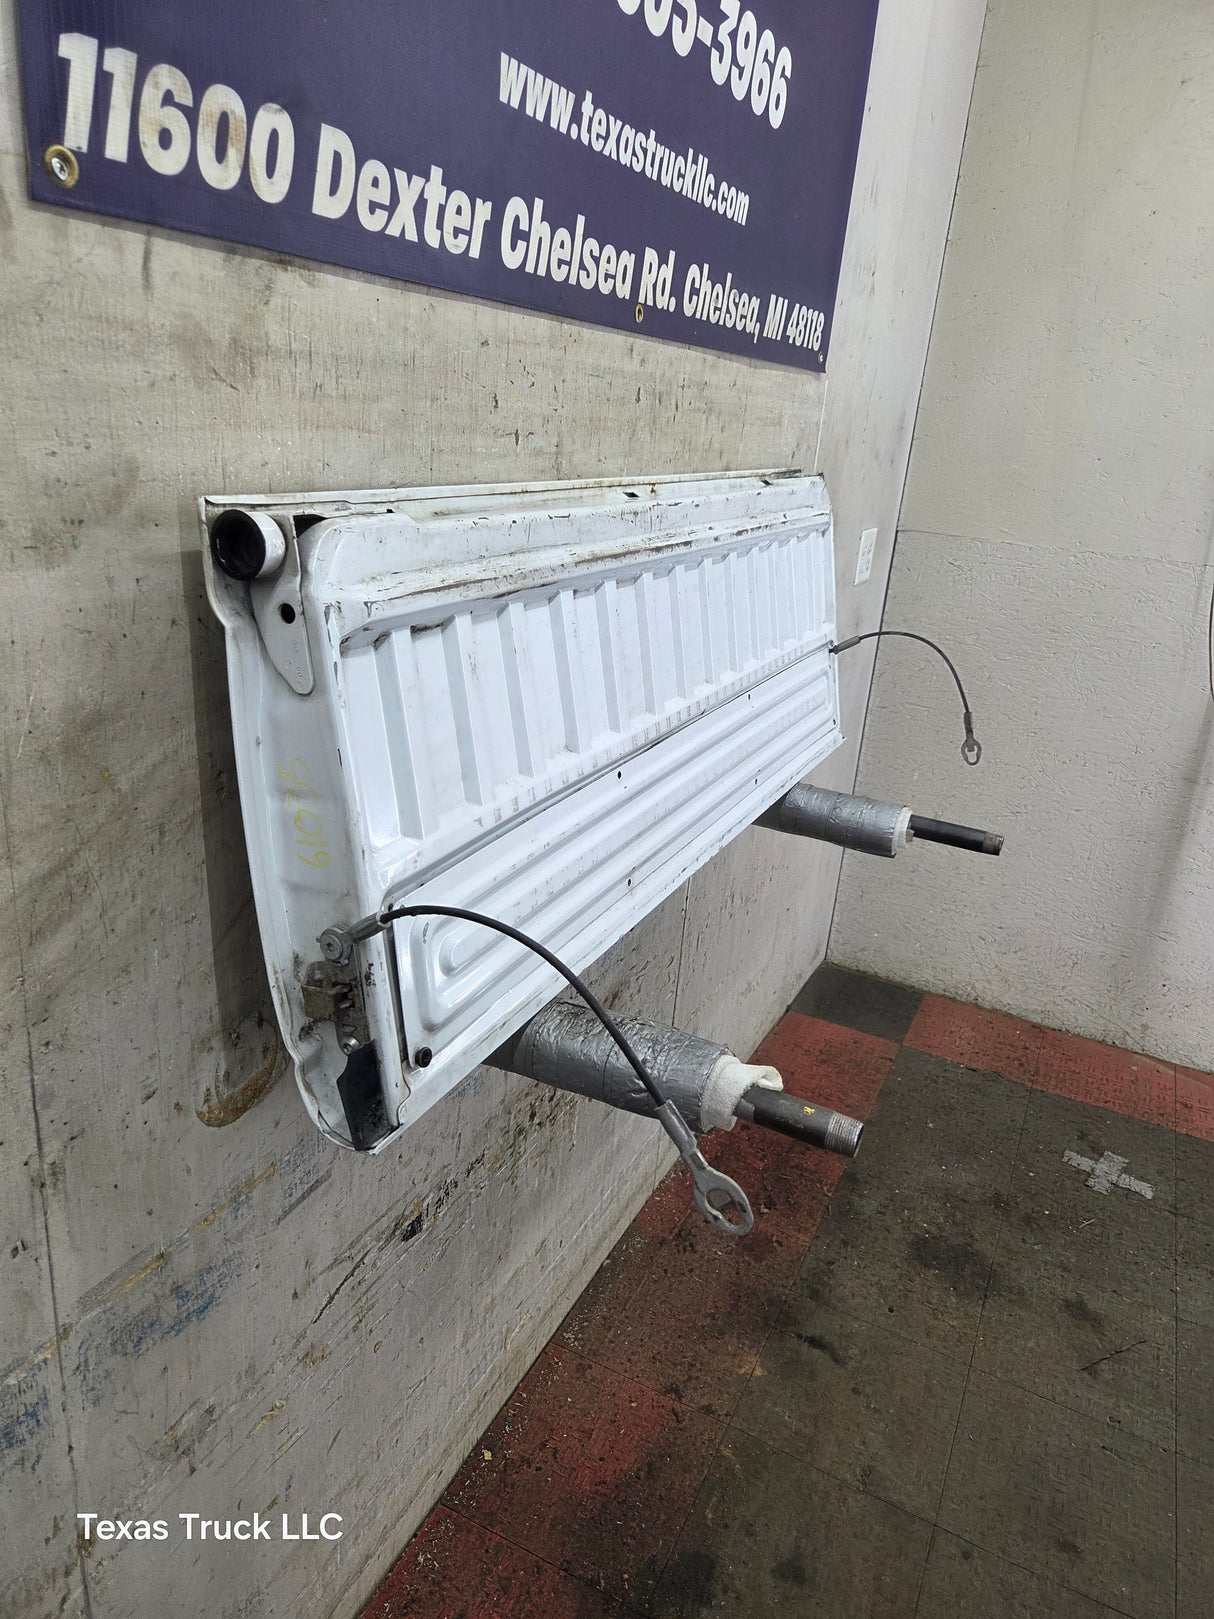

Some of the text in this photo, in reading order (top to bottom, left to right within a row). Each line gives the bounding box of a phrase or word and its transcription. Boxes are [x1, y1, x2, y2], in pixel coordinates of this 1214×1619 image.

[57, 32, 825, 352] 11600 Dexter Chelsea Rd. Chelsea, MI 48118
[499, 51, 750, 226] www.texastruckllc.com
